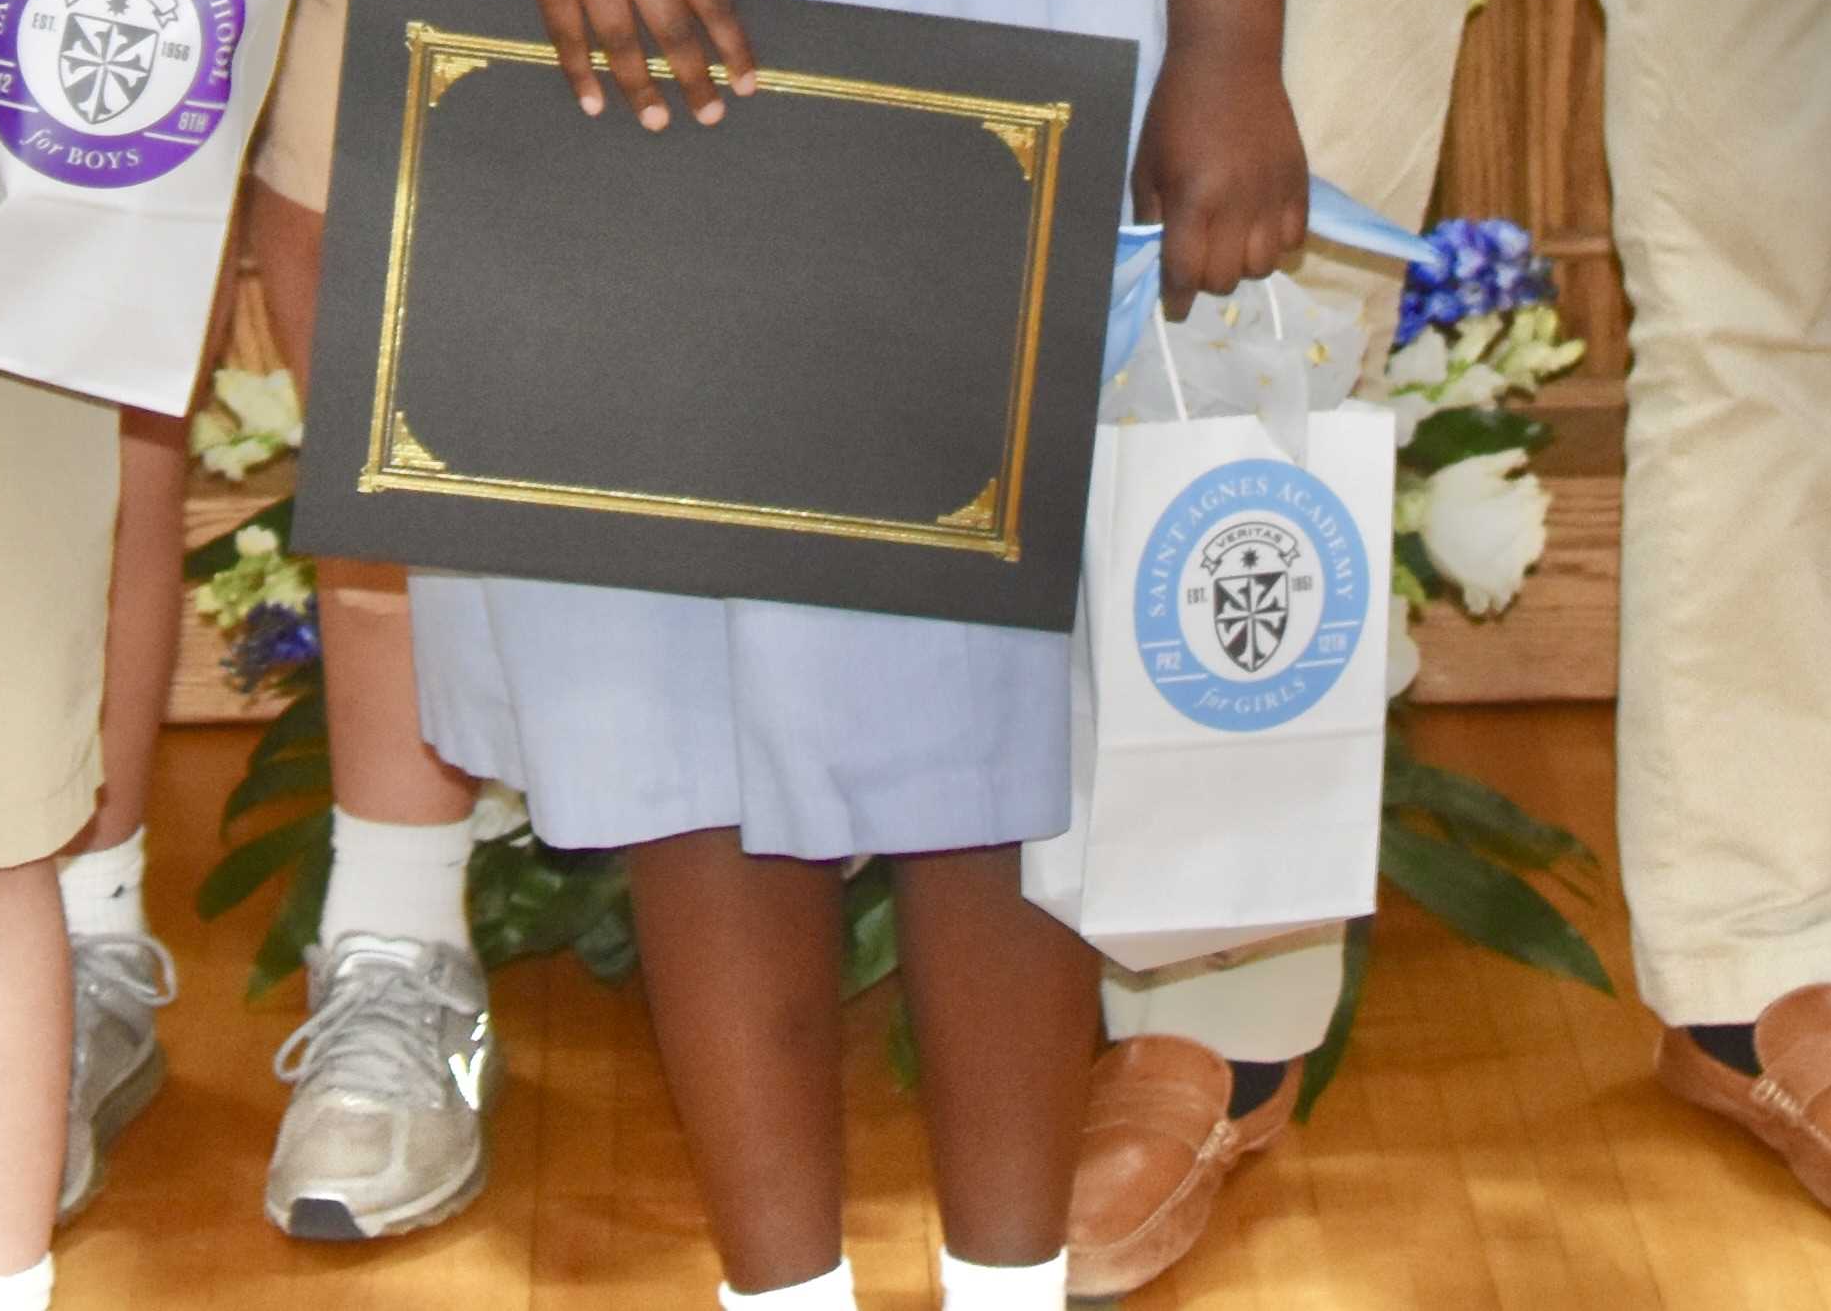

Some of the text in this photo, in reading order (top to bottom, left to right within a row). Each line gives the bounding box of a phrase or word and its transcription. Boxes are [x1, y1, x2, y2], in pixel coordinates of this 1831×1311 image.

[177, 110, 210, 134] 8TH
[19, 128, 141, 171] for BOYS
[1147, 476, 1354, 618] SAINT AGNES ACADEMY
[1217, 527, 1283, 549] VERITAS
[1193, 678, 1307, 715] for GIRLS
